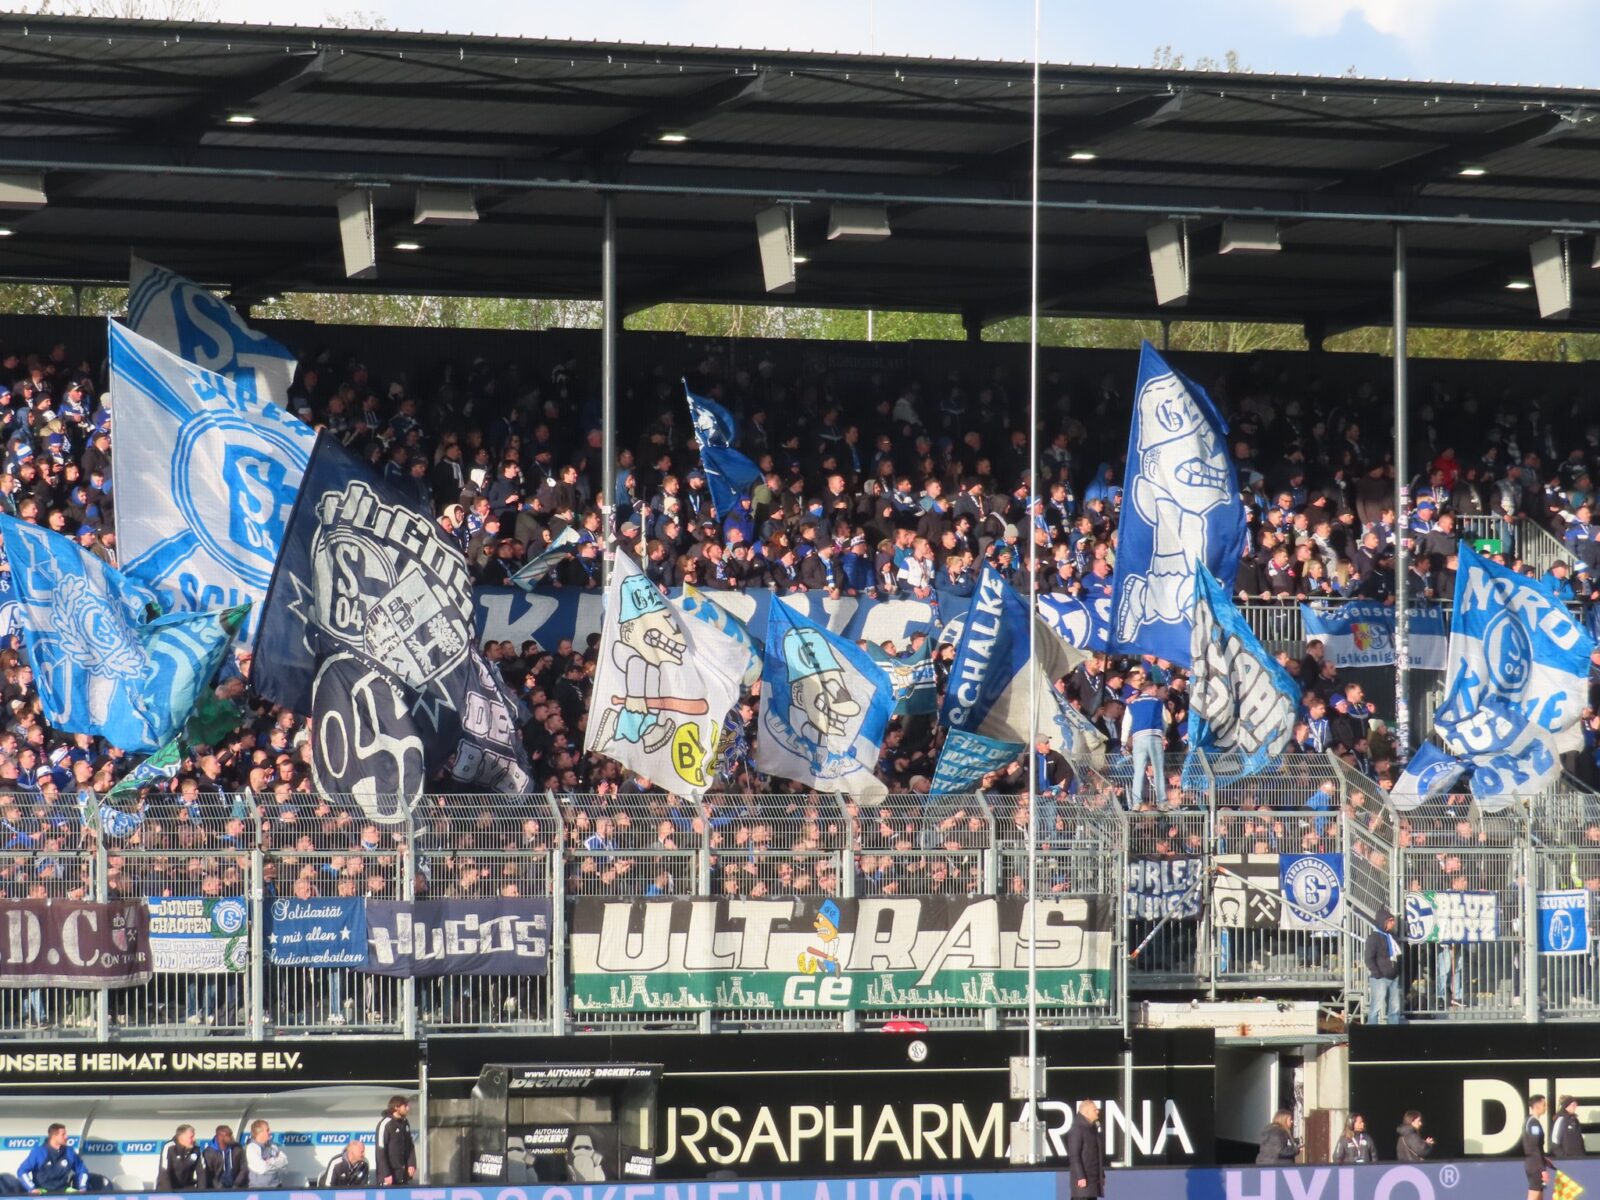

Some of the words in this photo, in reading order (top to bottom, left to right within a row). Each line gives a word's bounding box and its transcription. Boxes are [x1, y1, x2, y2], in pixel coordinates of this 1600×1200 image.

[271, 898, 343, 921] Solidarität
[282, 931, 302, 943] mit
[305, 926, 337, 941] allen
[81, 1053, 167, 1072] HEIMAT.
[172, 1053, 256, 1071] UNSERE
[261, 1051, 303, 1071] ELV.
[534, 1128, 569, 1136] AUTOHAUS
